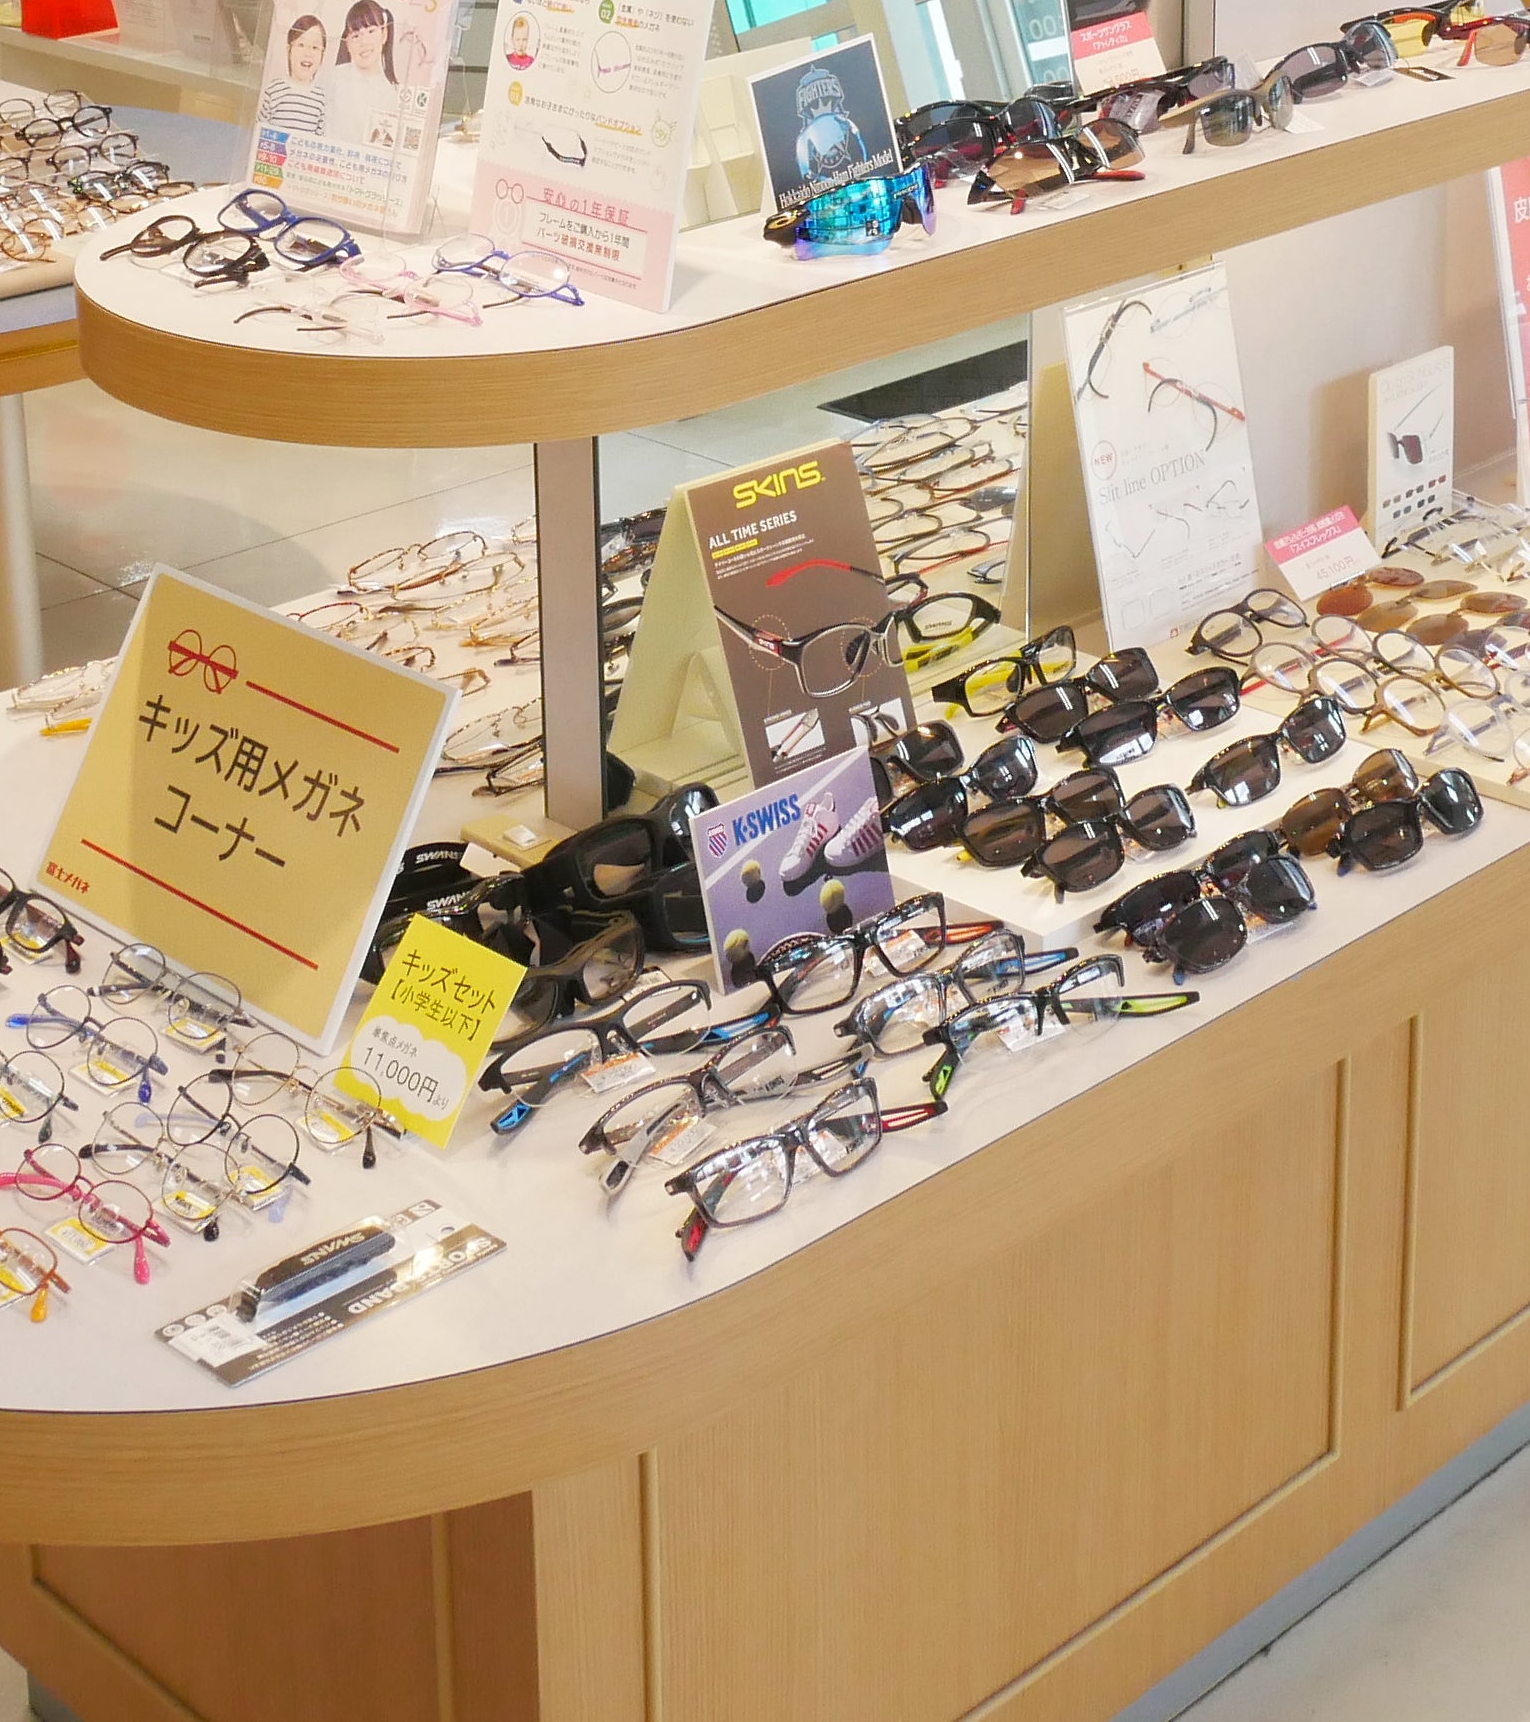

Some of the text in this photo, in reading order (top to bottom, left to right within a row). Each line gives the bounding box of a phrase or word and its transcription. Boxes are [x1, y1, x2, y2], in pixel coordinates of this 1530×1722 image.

[798, 78, 842, 105] FIGHTERS
[874, 149, 894, 169] Model
[543, 187, 630, 224] 安心の1年保証
[1094, 453, 1113, 466] NEW
[1150, 451, 1205, 485] OPTION
[709, 510, 798, 549] ALL TIME SERIES
[138, 695, 365, 838] キッズ用メガネ
[154, 784, 285, 867] コーナー
[402, 949, 496, 1014] キッズセット
[391, 978, 482, 1041] 【小学生以下】
[300, 1232, 365, 1265] SWANS
